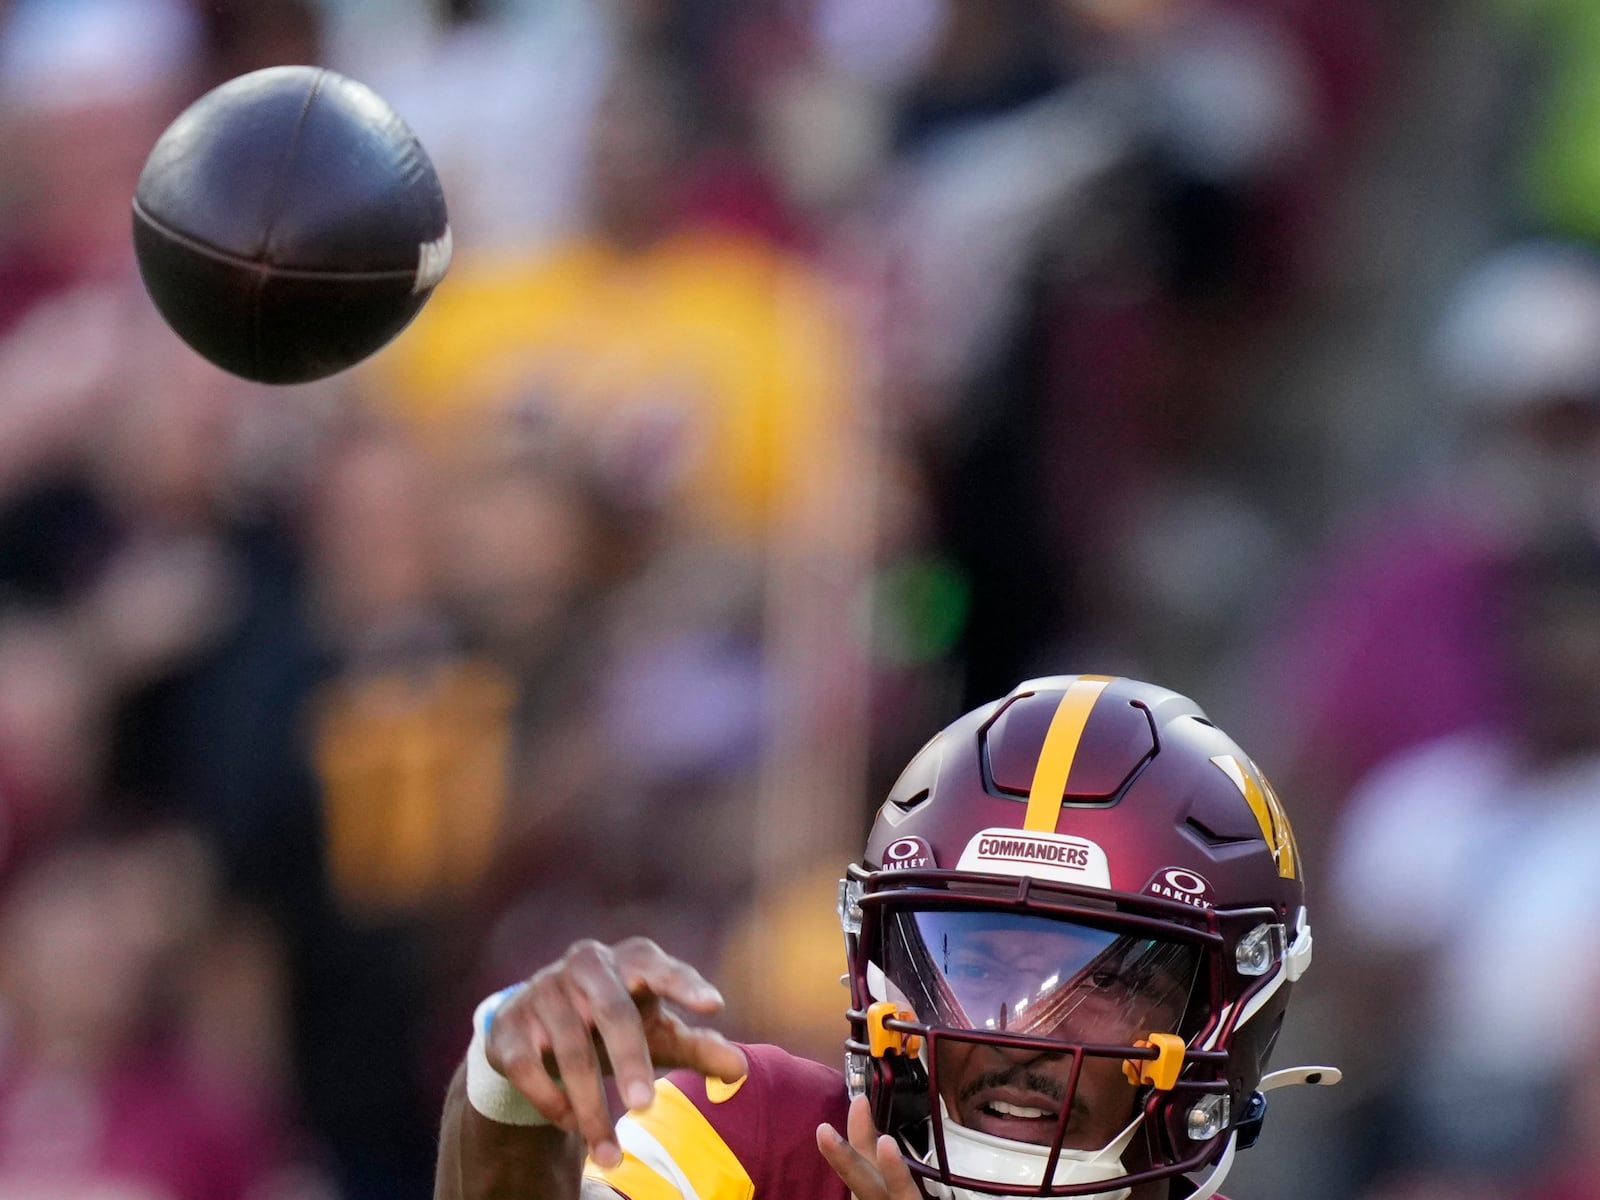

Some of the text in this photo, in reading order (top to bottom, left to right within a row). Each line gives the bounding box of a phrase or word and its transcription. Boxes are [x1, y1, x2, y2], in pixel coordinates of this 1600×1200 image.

[883, 858, 926, 872] OAKLEY
[978, 839, 1089, 866] COMMANDERS
[1151, 883, 1210, 909] OAKLEY
